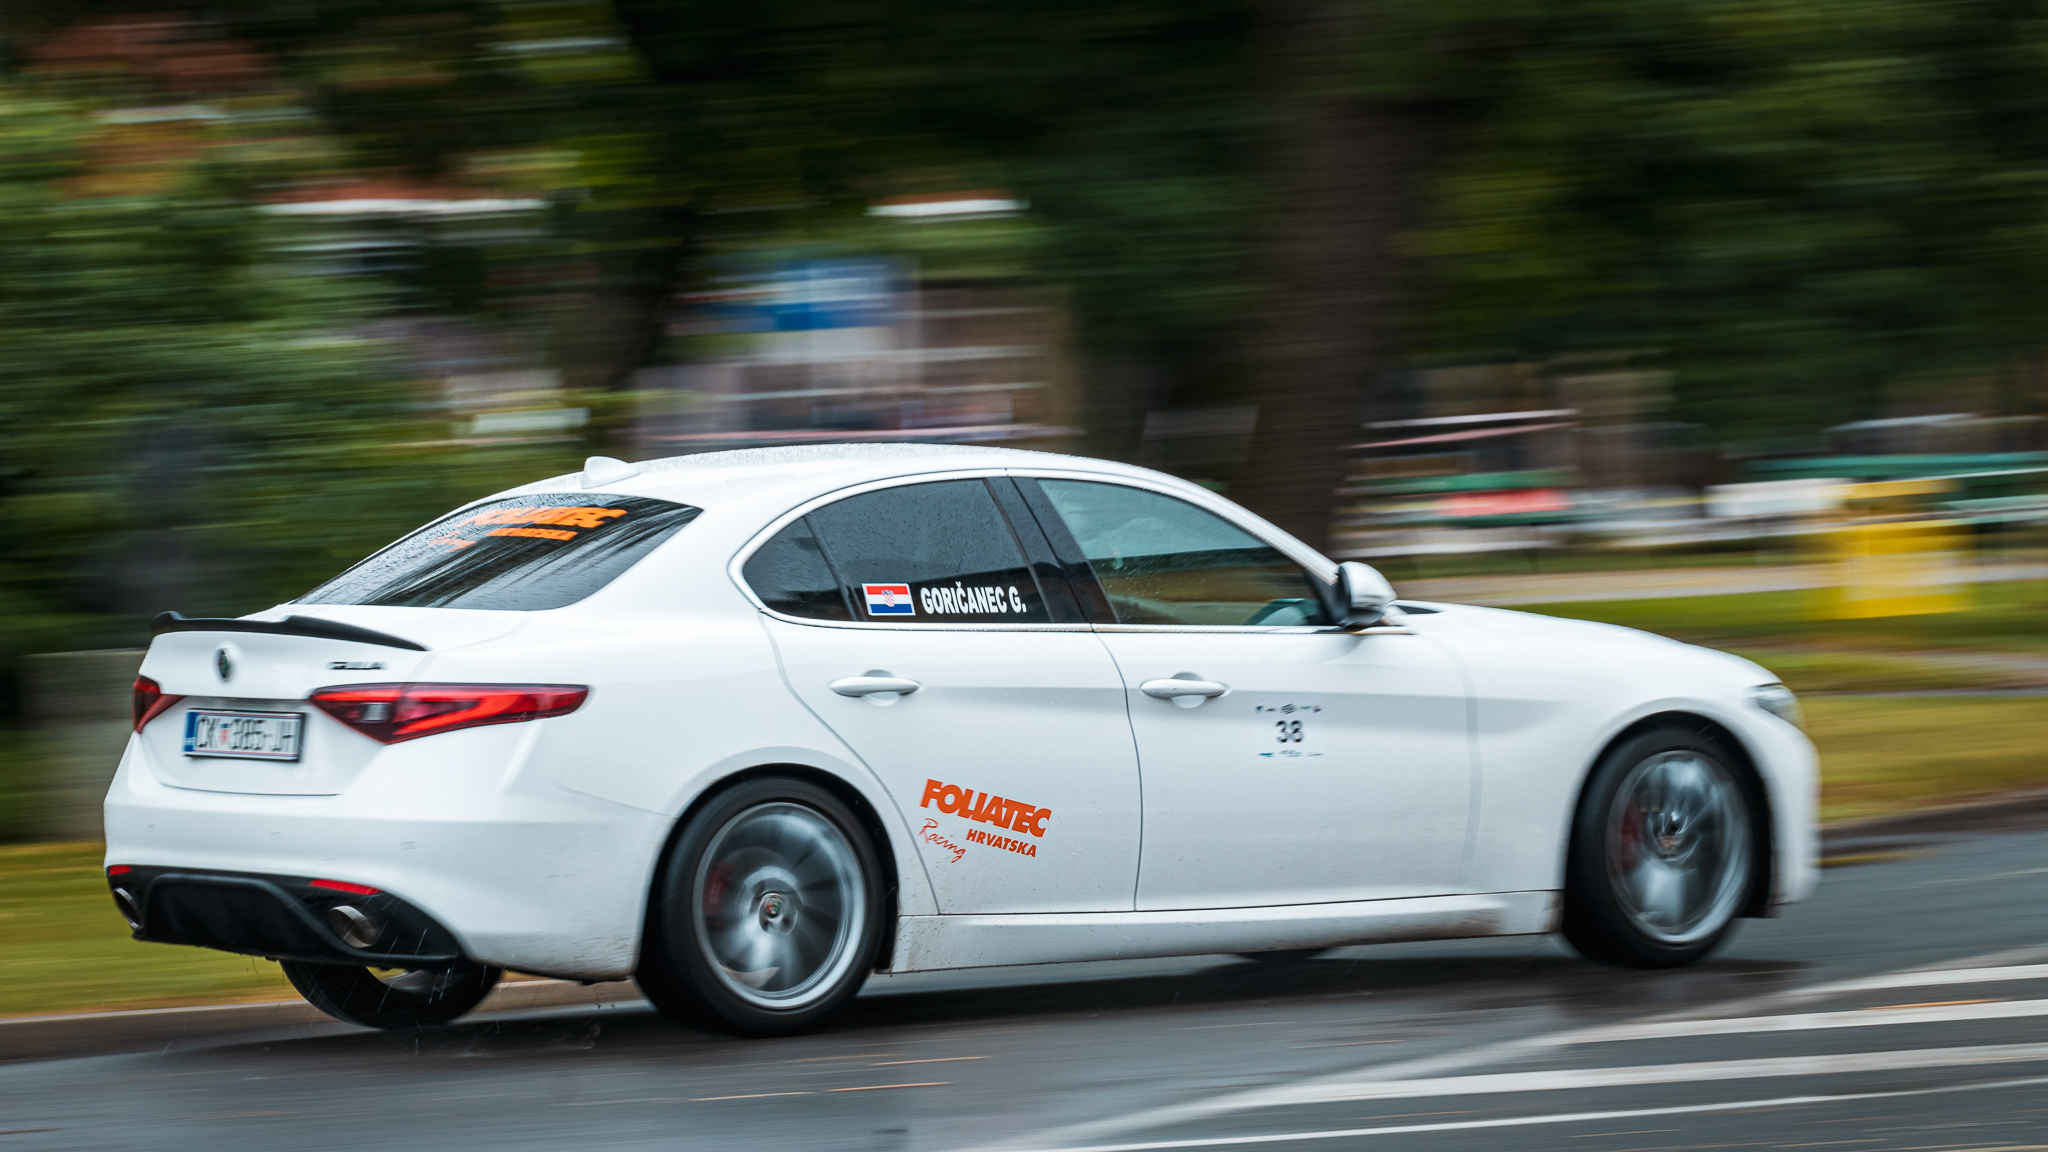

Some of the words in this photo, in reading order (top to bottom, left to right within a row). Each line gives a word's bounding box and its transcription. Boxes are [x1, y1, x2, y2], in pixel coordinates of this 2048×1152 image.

[920, 581, 1008, 614] GORIČANEC
[1008, 586, 1027, 613] G.
[1275, 720, 1303, 743] 38
[920, 778, 1052, 837] FOLIATEC
[919, 818, 966, 863] Racing
[966, 828, 1037, 857] HRVATSKA
